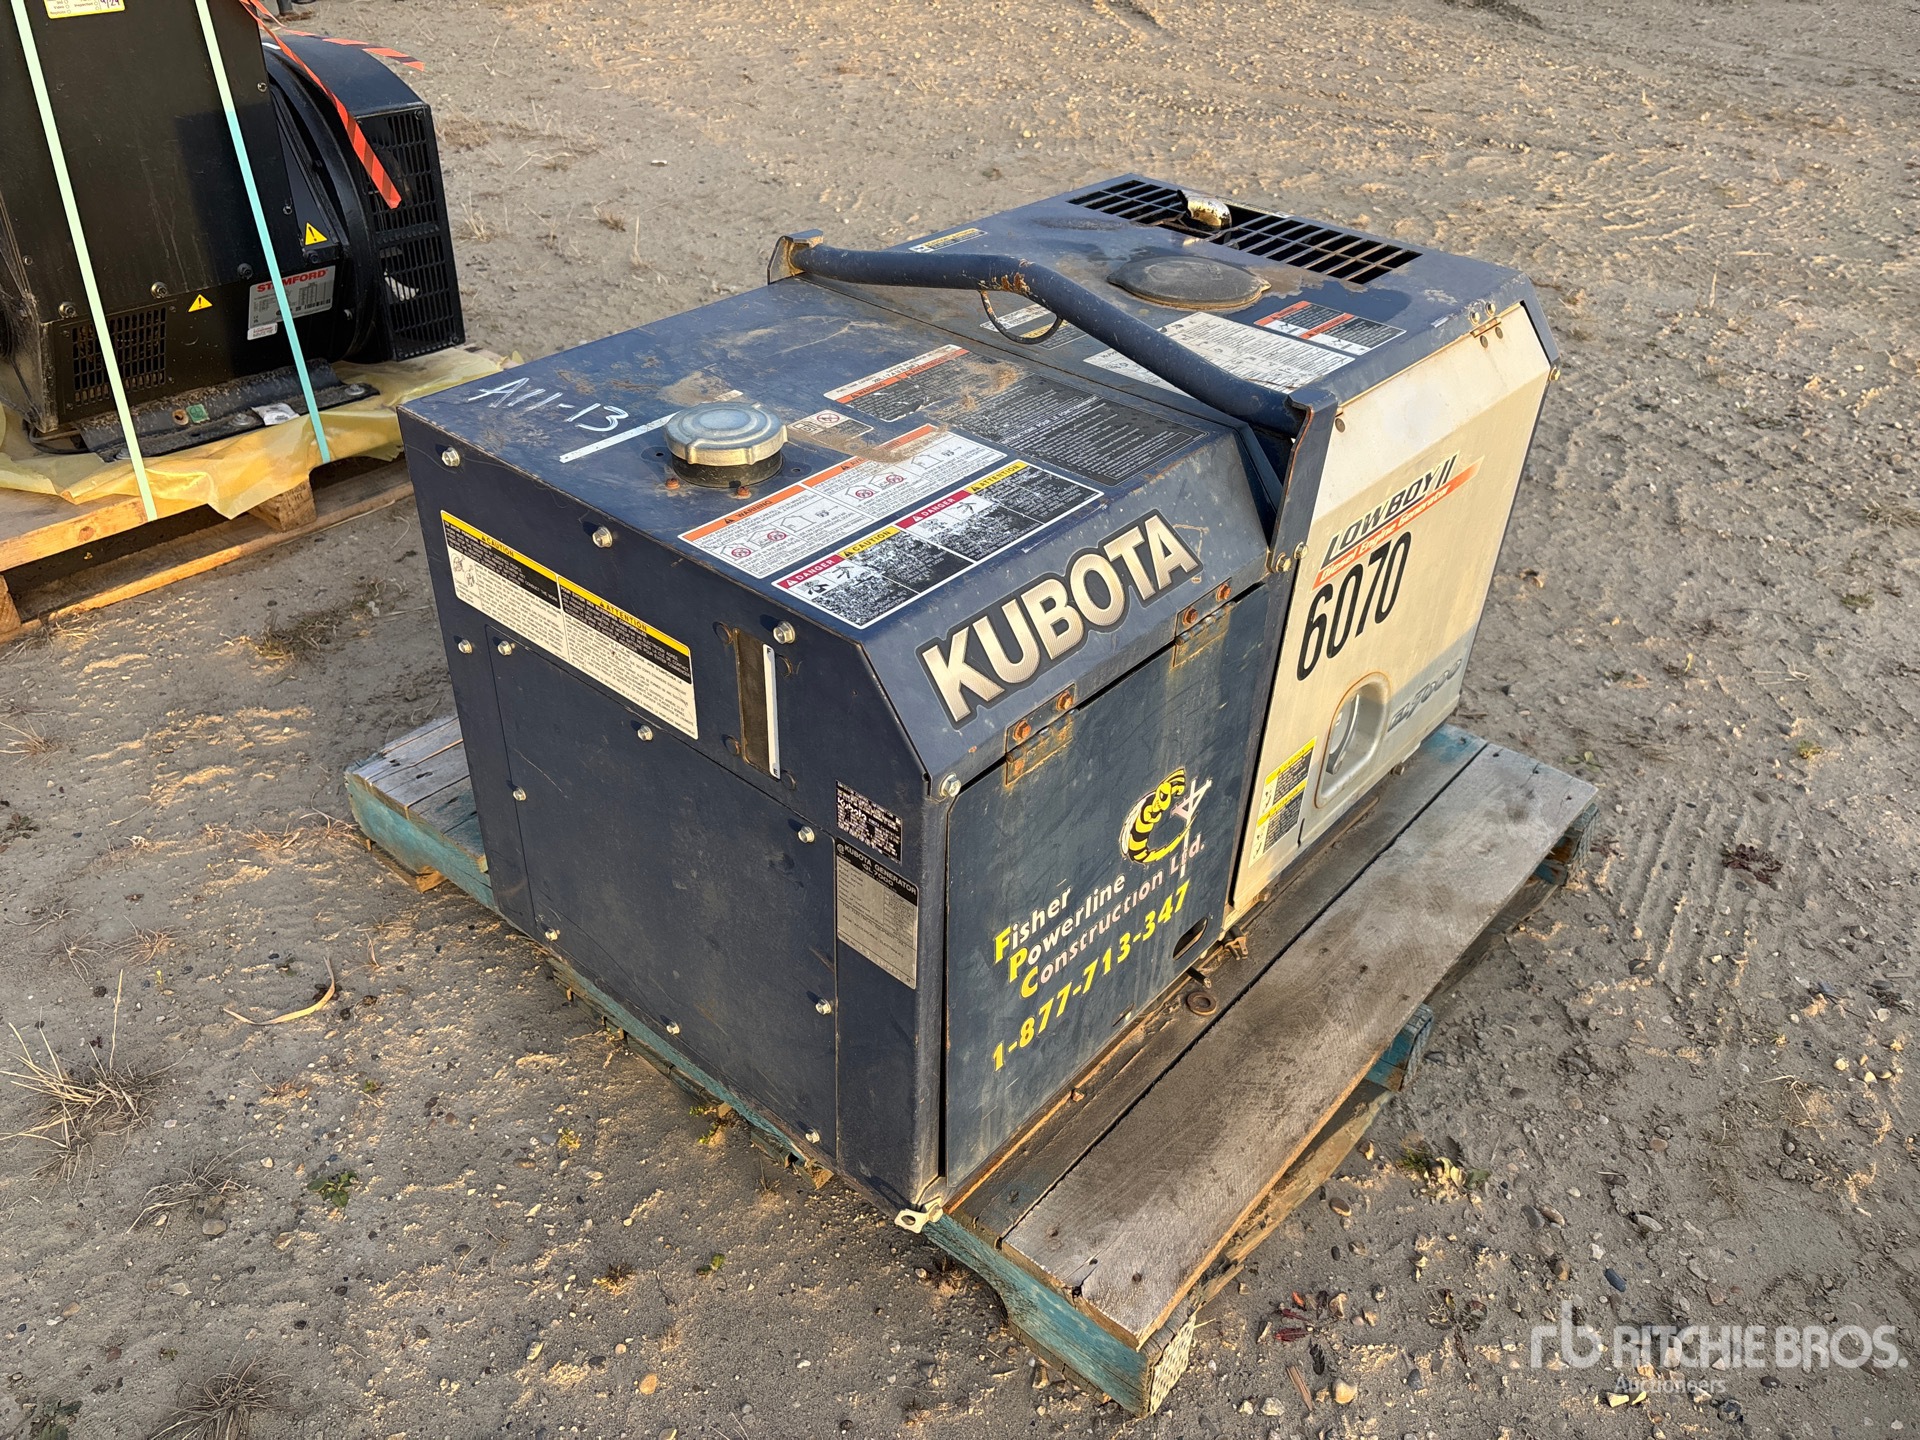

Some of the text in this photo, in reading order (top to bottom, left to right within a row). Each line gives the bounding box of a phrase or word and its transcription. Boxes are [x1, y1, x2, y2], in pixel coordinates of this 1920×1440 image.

[257, 269, 327, 292] STMFORD
[980, 464, 1020, 488] ATTENTION
[736, 500, 773, 518] WARNING
[921, 498, 956, 517] DANGER
[1321, 465, 1440, 570] LOWBOY
[486, 536, 515, 557] CAUTION
[852, 530, 891, 552] CAUTION
[1320, 485, 1451, 582] Diesel Engine Generator
[795, 559, 835, 581] DANGER
[606, 603, 648, 632] ATTENTION
[921, 514, 1200, 722] KUBOTA
[1297, 531, 1412, 682] 6070
[845, 844, 917, 895] KUBOTA GENERATOR
[993, 886, 1072, 966] Fisher
[1007, 873, 1127, 983] Powerline
[1020, 869, 1163, 999] Construction
[992, 881, 1190, 1072] 1-877-713-347
